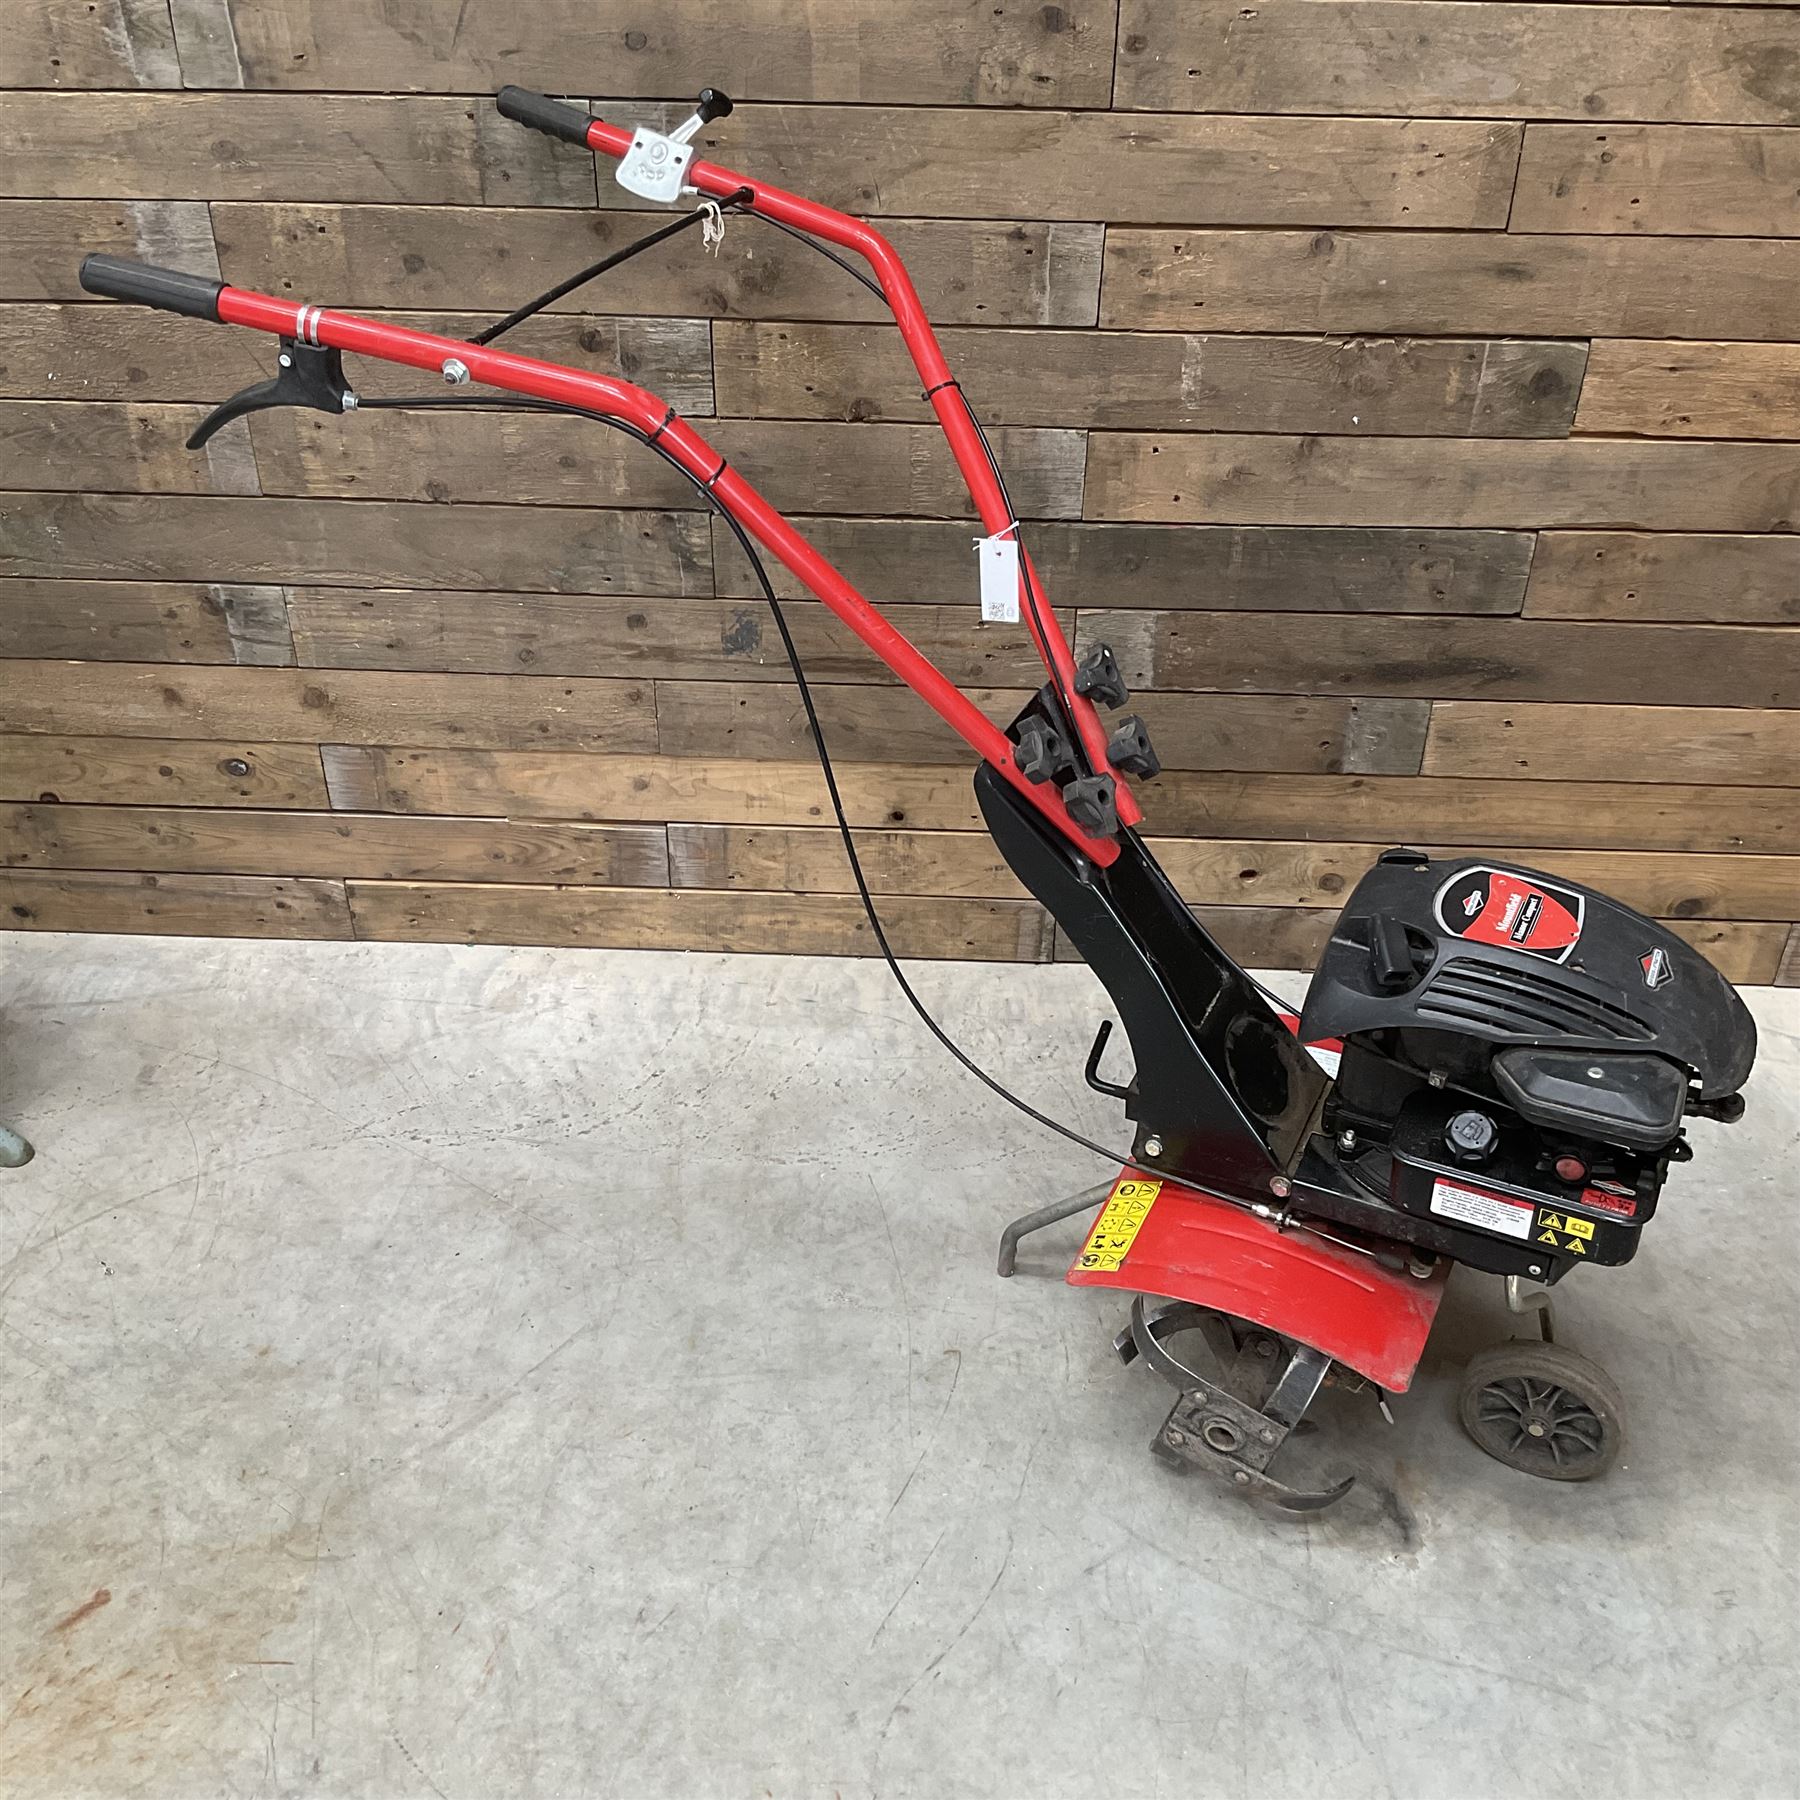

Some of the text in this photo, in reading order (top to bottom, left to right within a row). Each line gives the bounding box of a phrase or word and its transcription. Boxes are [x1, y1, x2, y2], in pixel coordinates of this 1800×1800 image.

[1496, 893, 1522, 932] Mountfield
[1514, 898, 1539, 940] Manor Compact
